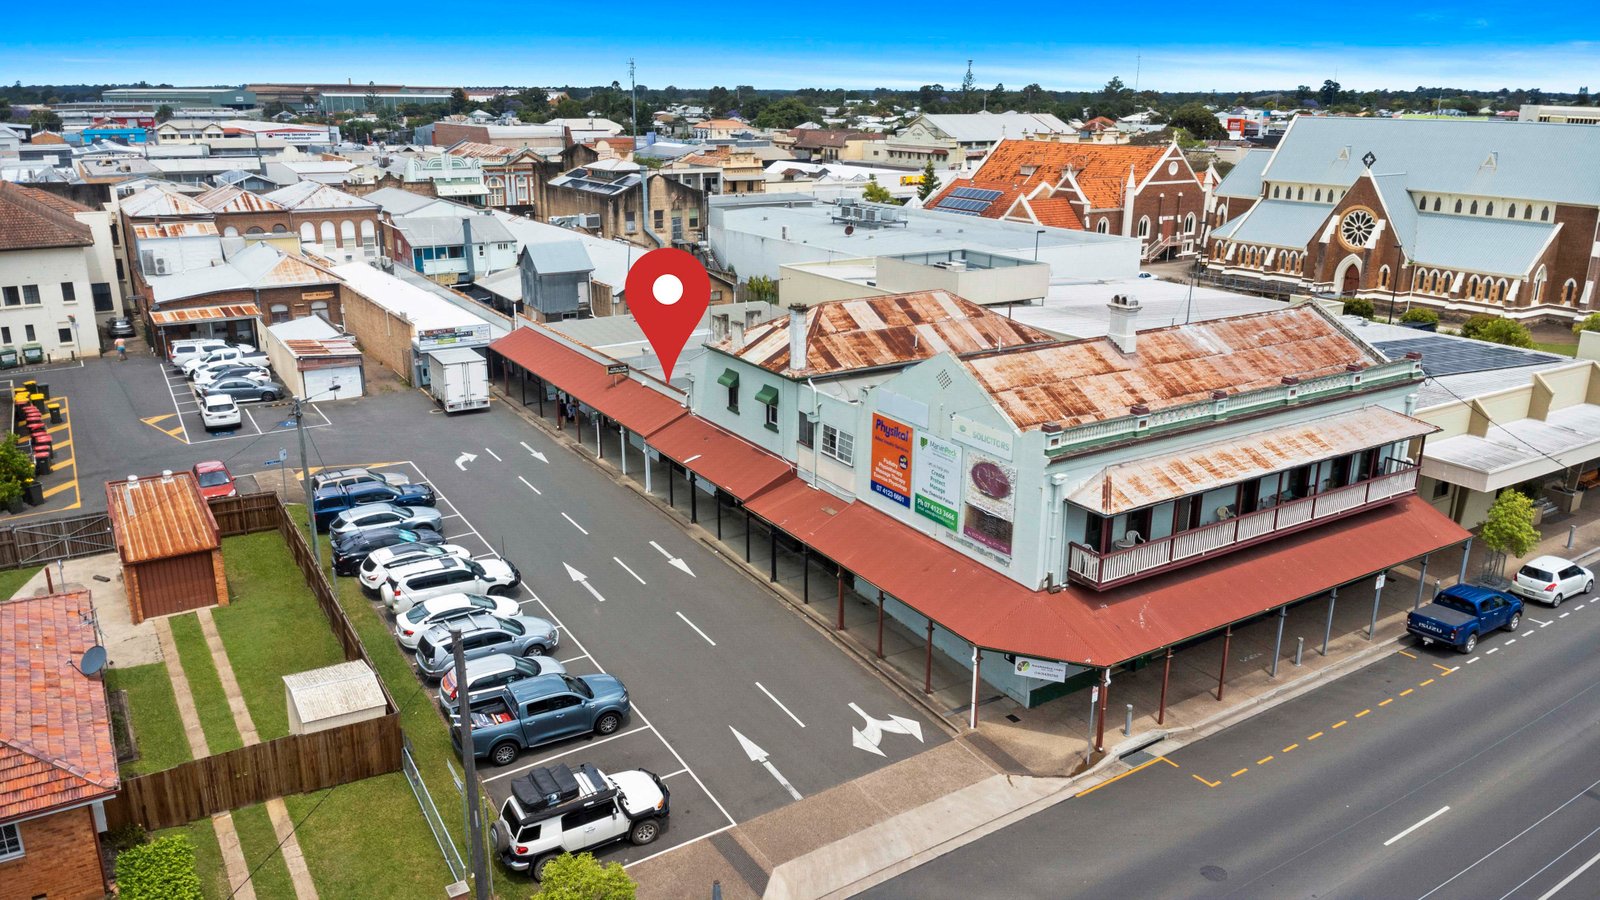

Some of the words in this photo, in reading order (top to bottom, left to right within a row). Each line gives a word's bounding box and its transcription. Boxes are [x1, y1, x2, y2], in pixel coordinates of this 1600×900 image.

[875, 418, 909, 442] Physikal
[973, 431, 1009, 451] SOLICITORS
[931, 469, 945, 479] Create
[930, 475, 946, 487] Protect
[930, 482, 946, 494] Manage
[930, 504, 942, 514] 4123
[1418, 622, 1442, 633] ISUZU
